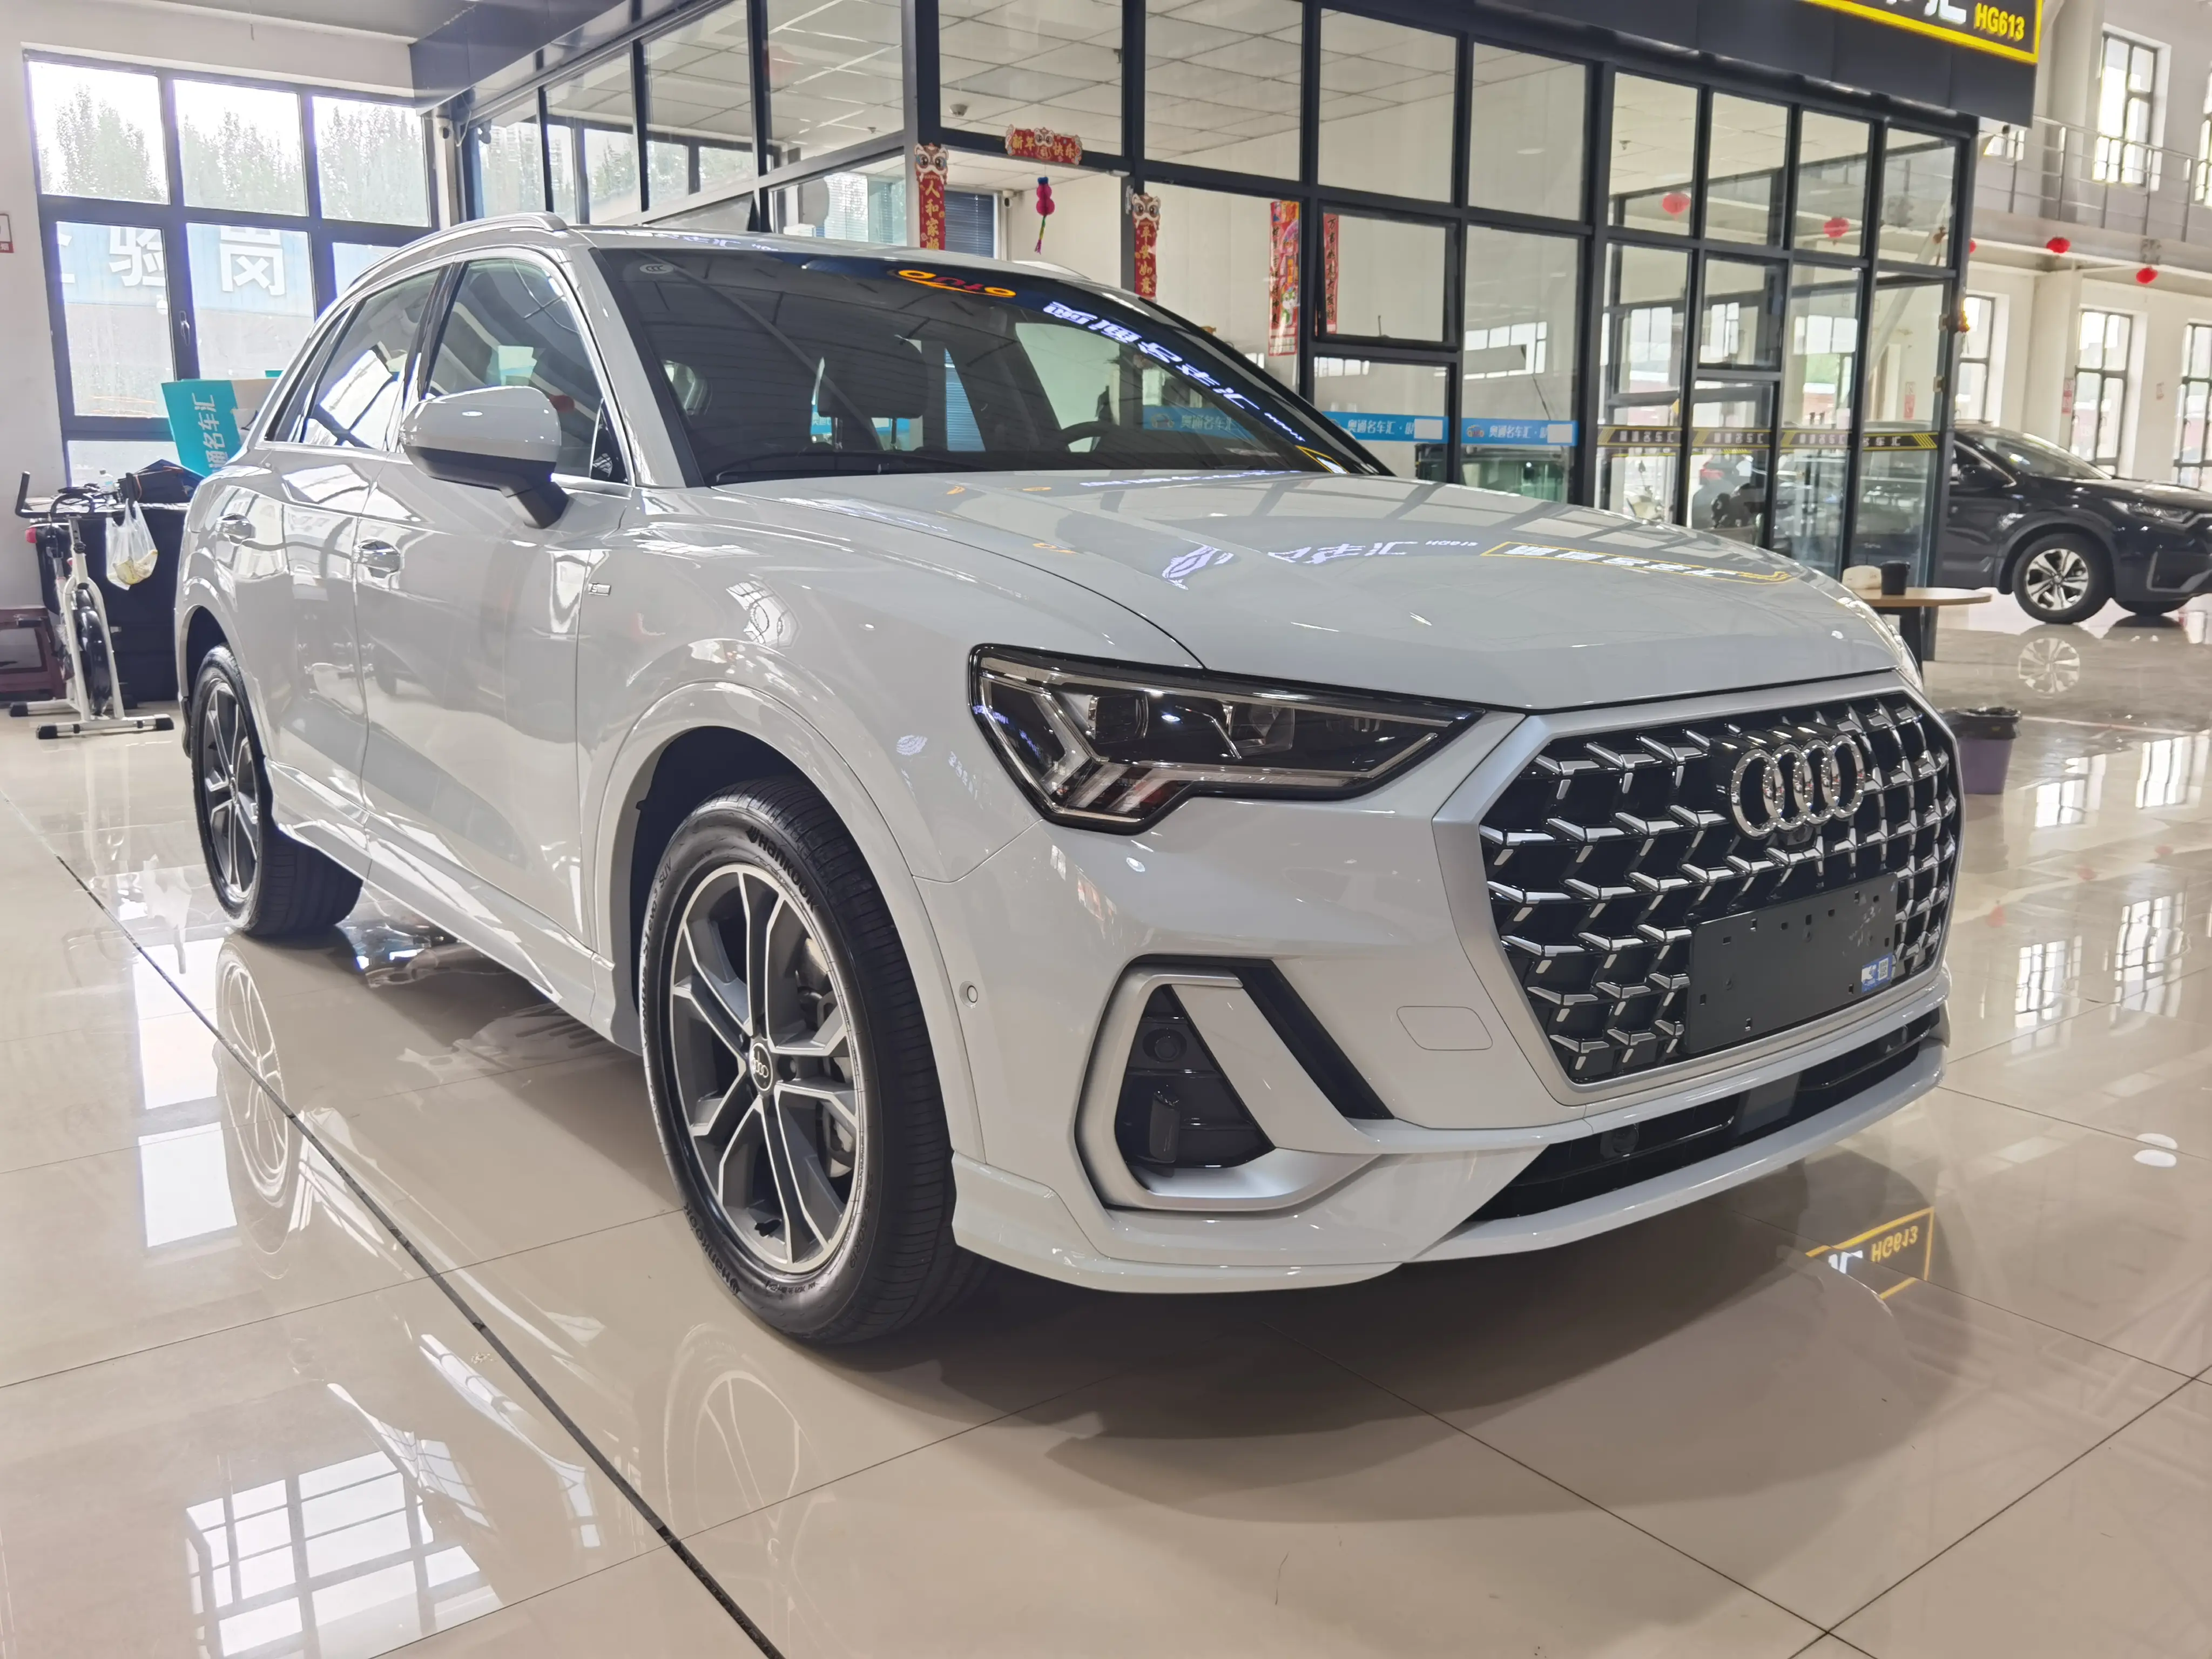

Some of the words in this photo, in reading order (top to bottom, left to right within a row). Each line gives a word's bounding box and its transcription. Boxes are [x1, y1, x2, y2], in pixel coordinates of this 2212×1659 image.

[1975, 3, 2025, 41] HG613
[57, 226, 286, 296] 验岗
[1139, 226, 1153, 294] 平安如意
[192, 392, 229, 474] 通名车汇
